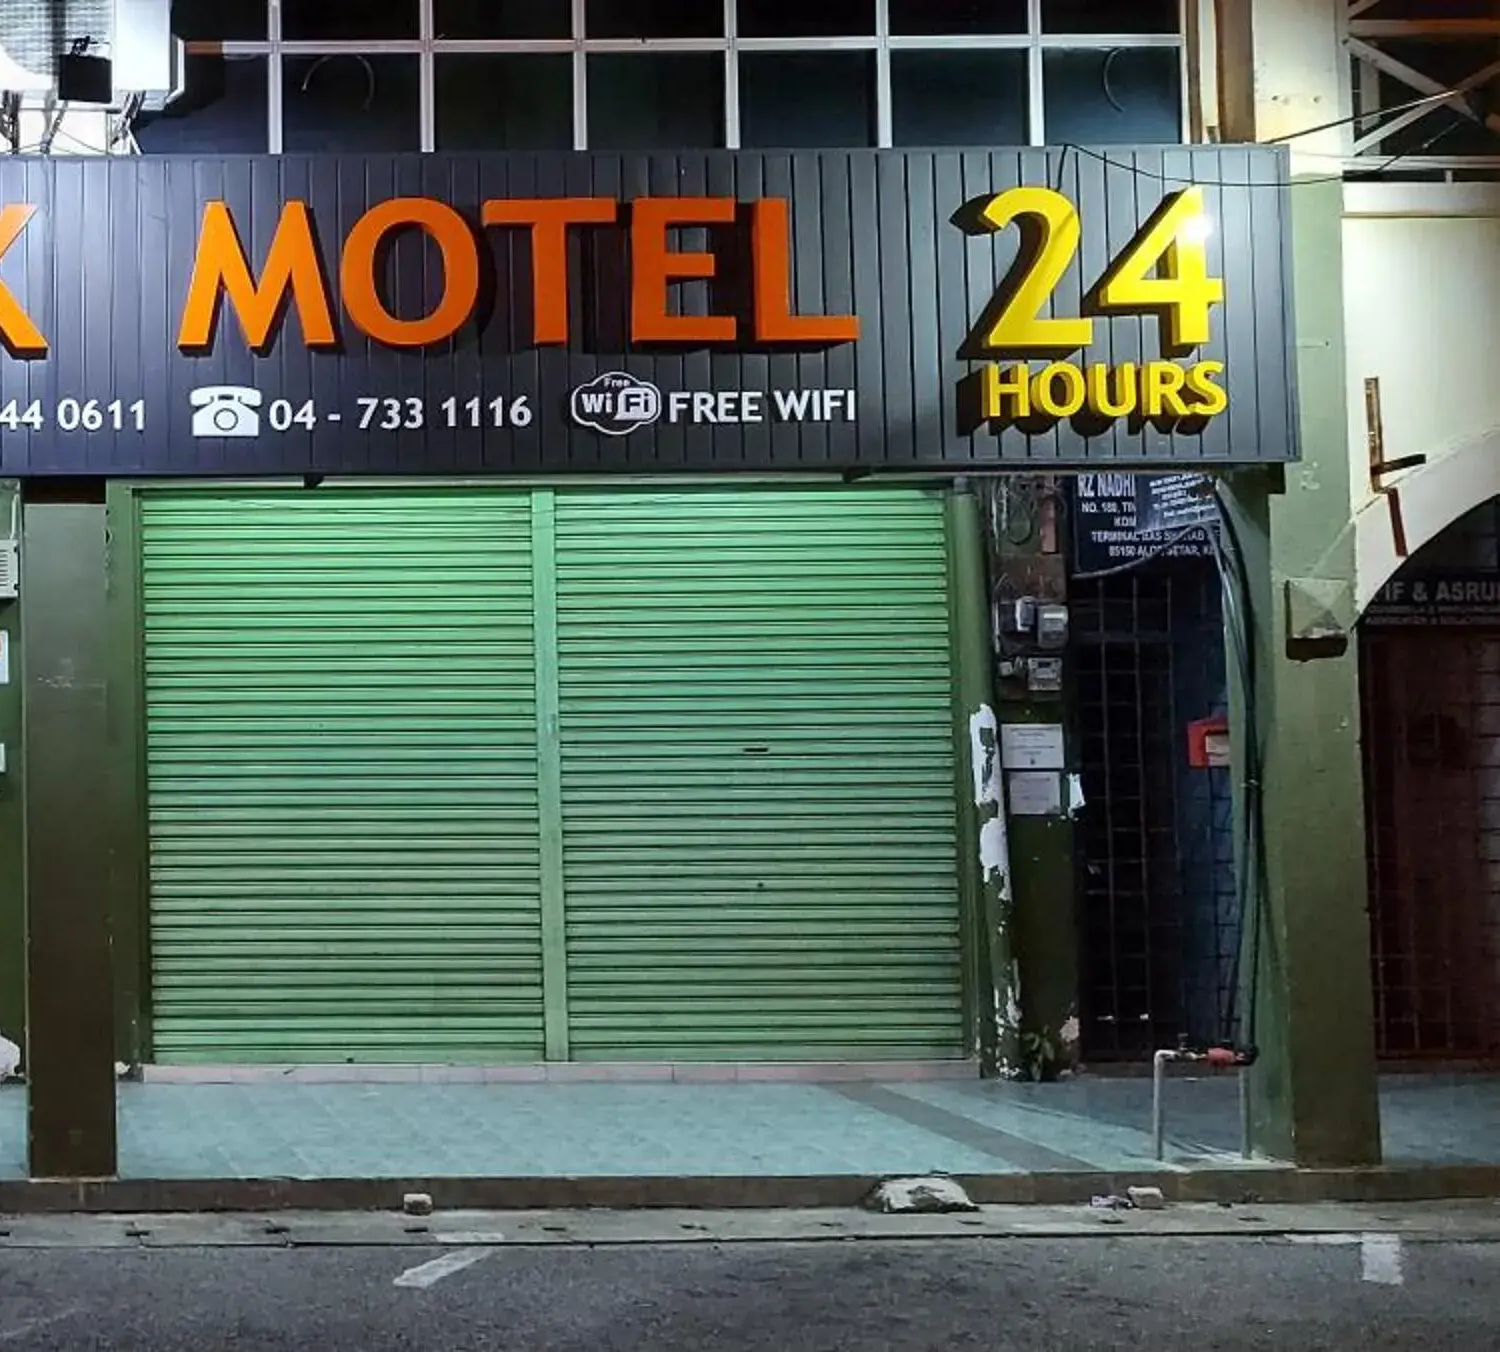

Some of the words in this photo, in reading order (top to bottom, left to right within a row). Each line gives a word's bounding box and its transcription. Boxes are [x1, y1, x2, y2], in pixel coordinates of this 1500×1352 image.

[177, 197, 860, 354] MOTEL
[981, 186, 1224, 348] 24
[603, 377, 630, 388] Free
[981, 360, 1228, 418] HOURS
[57, 399, 147, 431] 0611
[269, 399, 317, 431] 04
[327, 414, 341, 422] -
[357, 398, 424, 430] 733
[442, 396, 533, 428] 1116
[669, 391, 763, 424] FREE
[774, 389, 856, 422] WIFI
[1374, 581, 1405, 602] IF
[1412, 581, 1428, 602] &
[1435, 580, 1500, 602] ASRU
